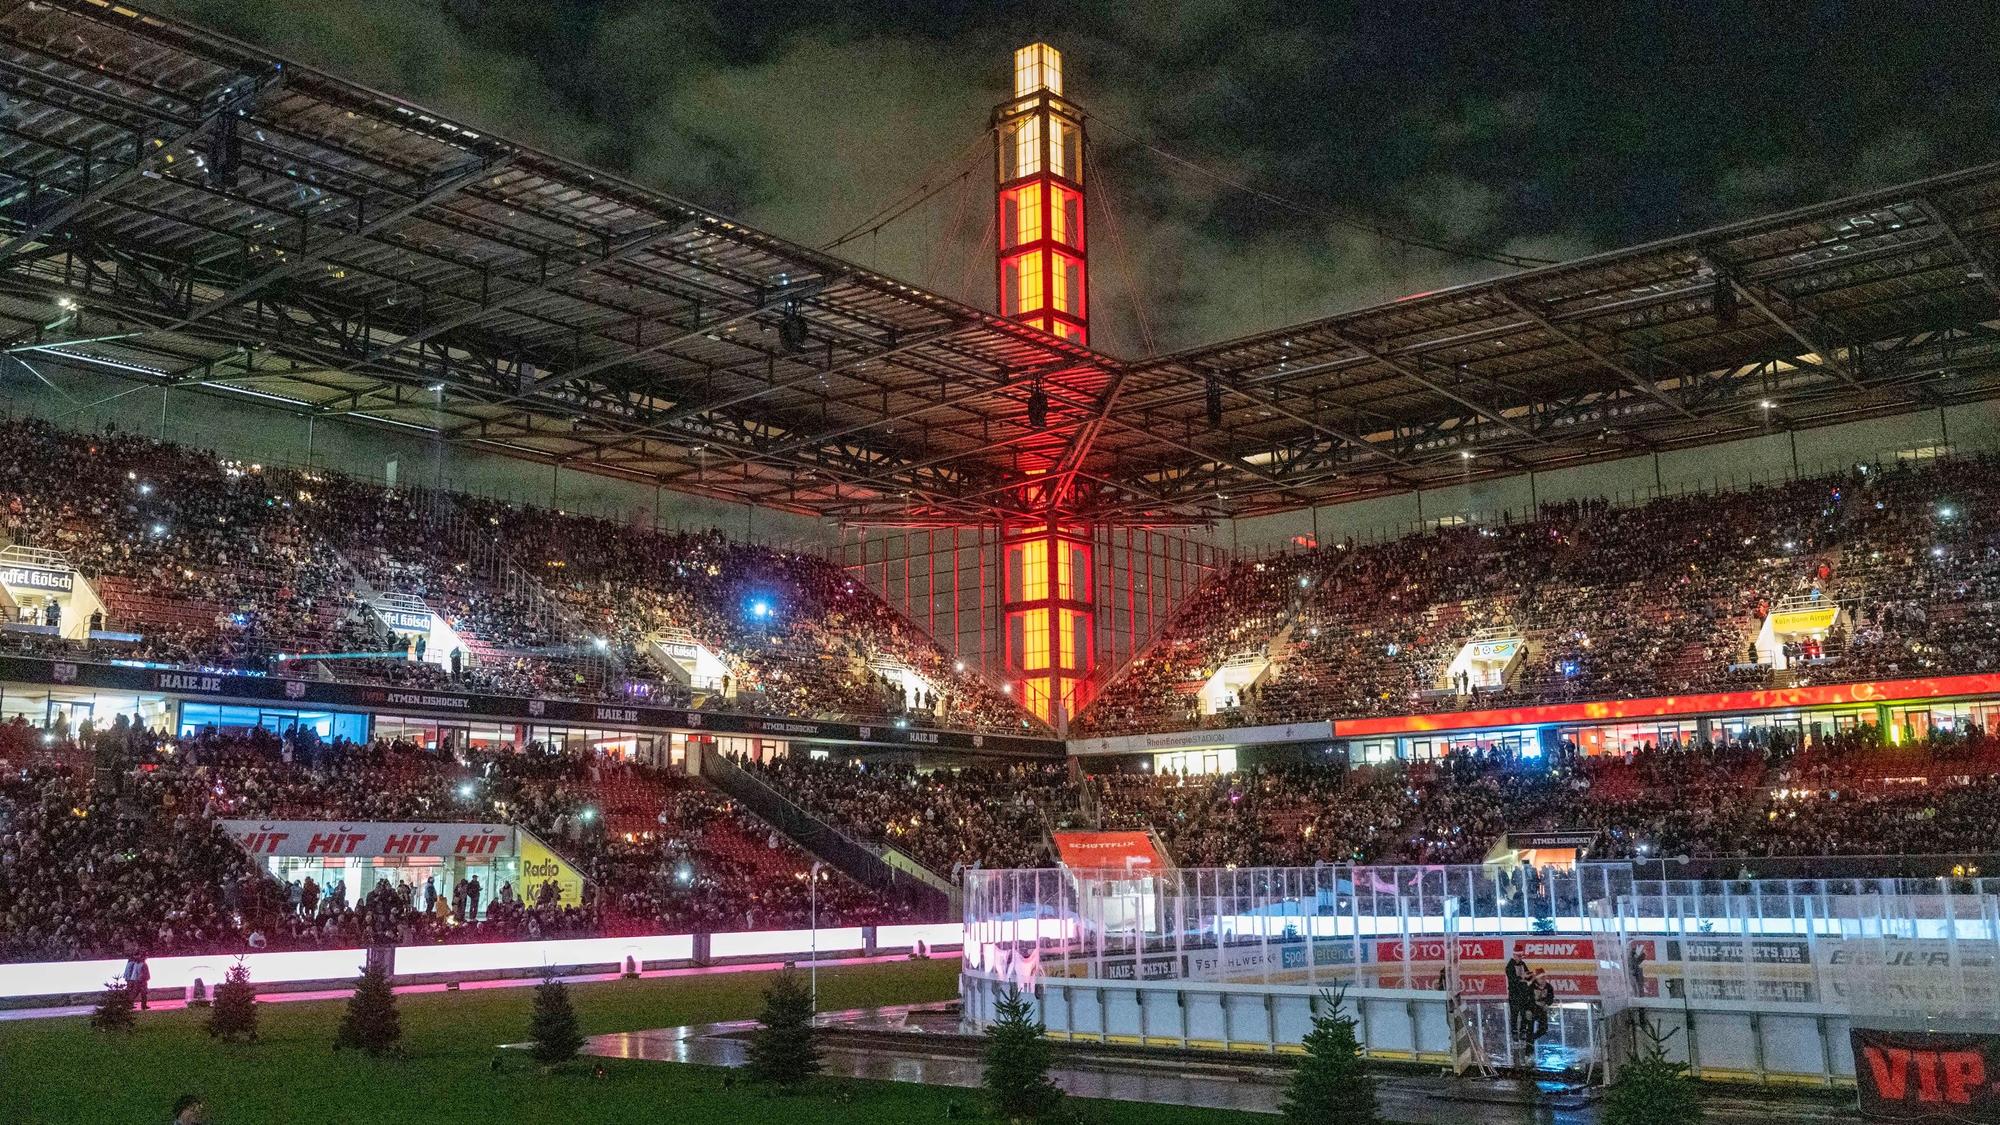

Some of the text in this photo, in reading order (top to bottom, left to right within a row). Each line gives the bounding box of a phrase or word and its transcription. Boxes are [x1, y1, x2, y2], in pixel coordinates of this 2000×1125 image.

[160, 674, 221, 692] HAIE.DE
[597, 708, 638, 721] HAIE.DE
[307, 833, 367, 853] HIT
[383, 834, 439, 854] HIT
[454, 835, 507, 854] HIT
[523, 858, 559, 877] Radio
[1863, 1047, 1984, 1104] VIP
